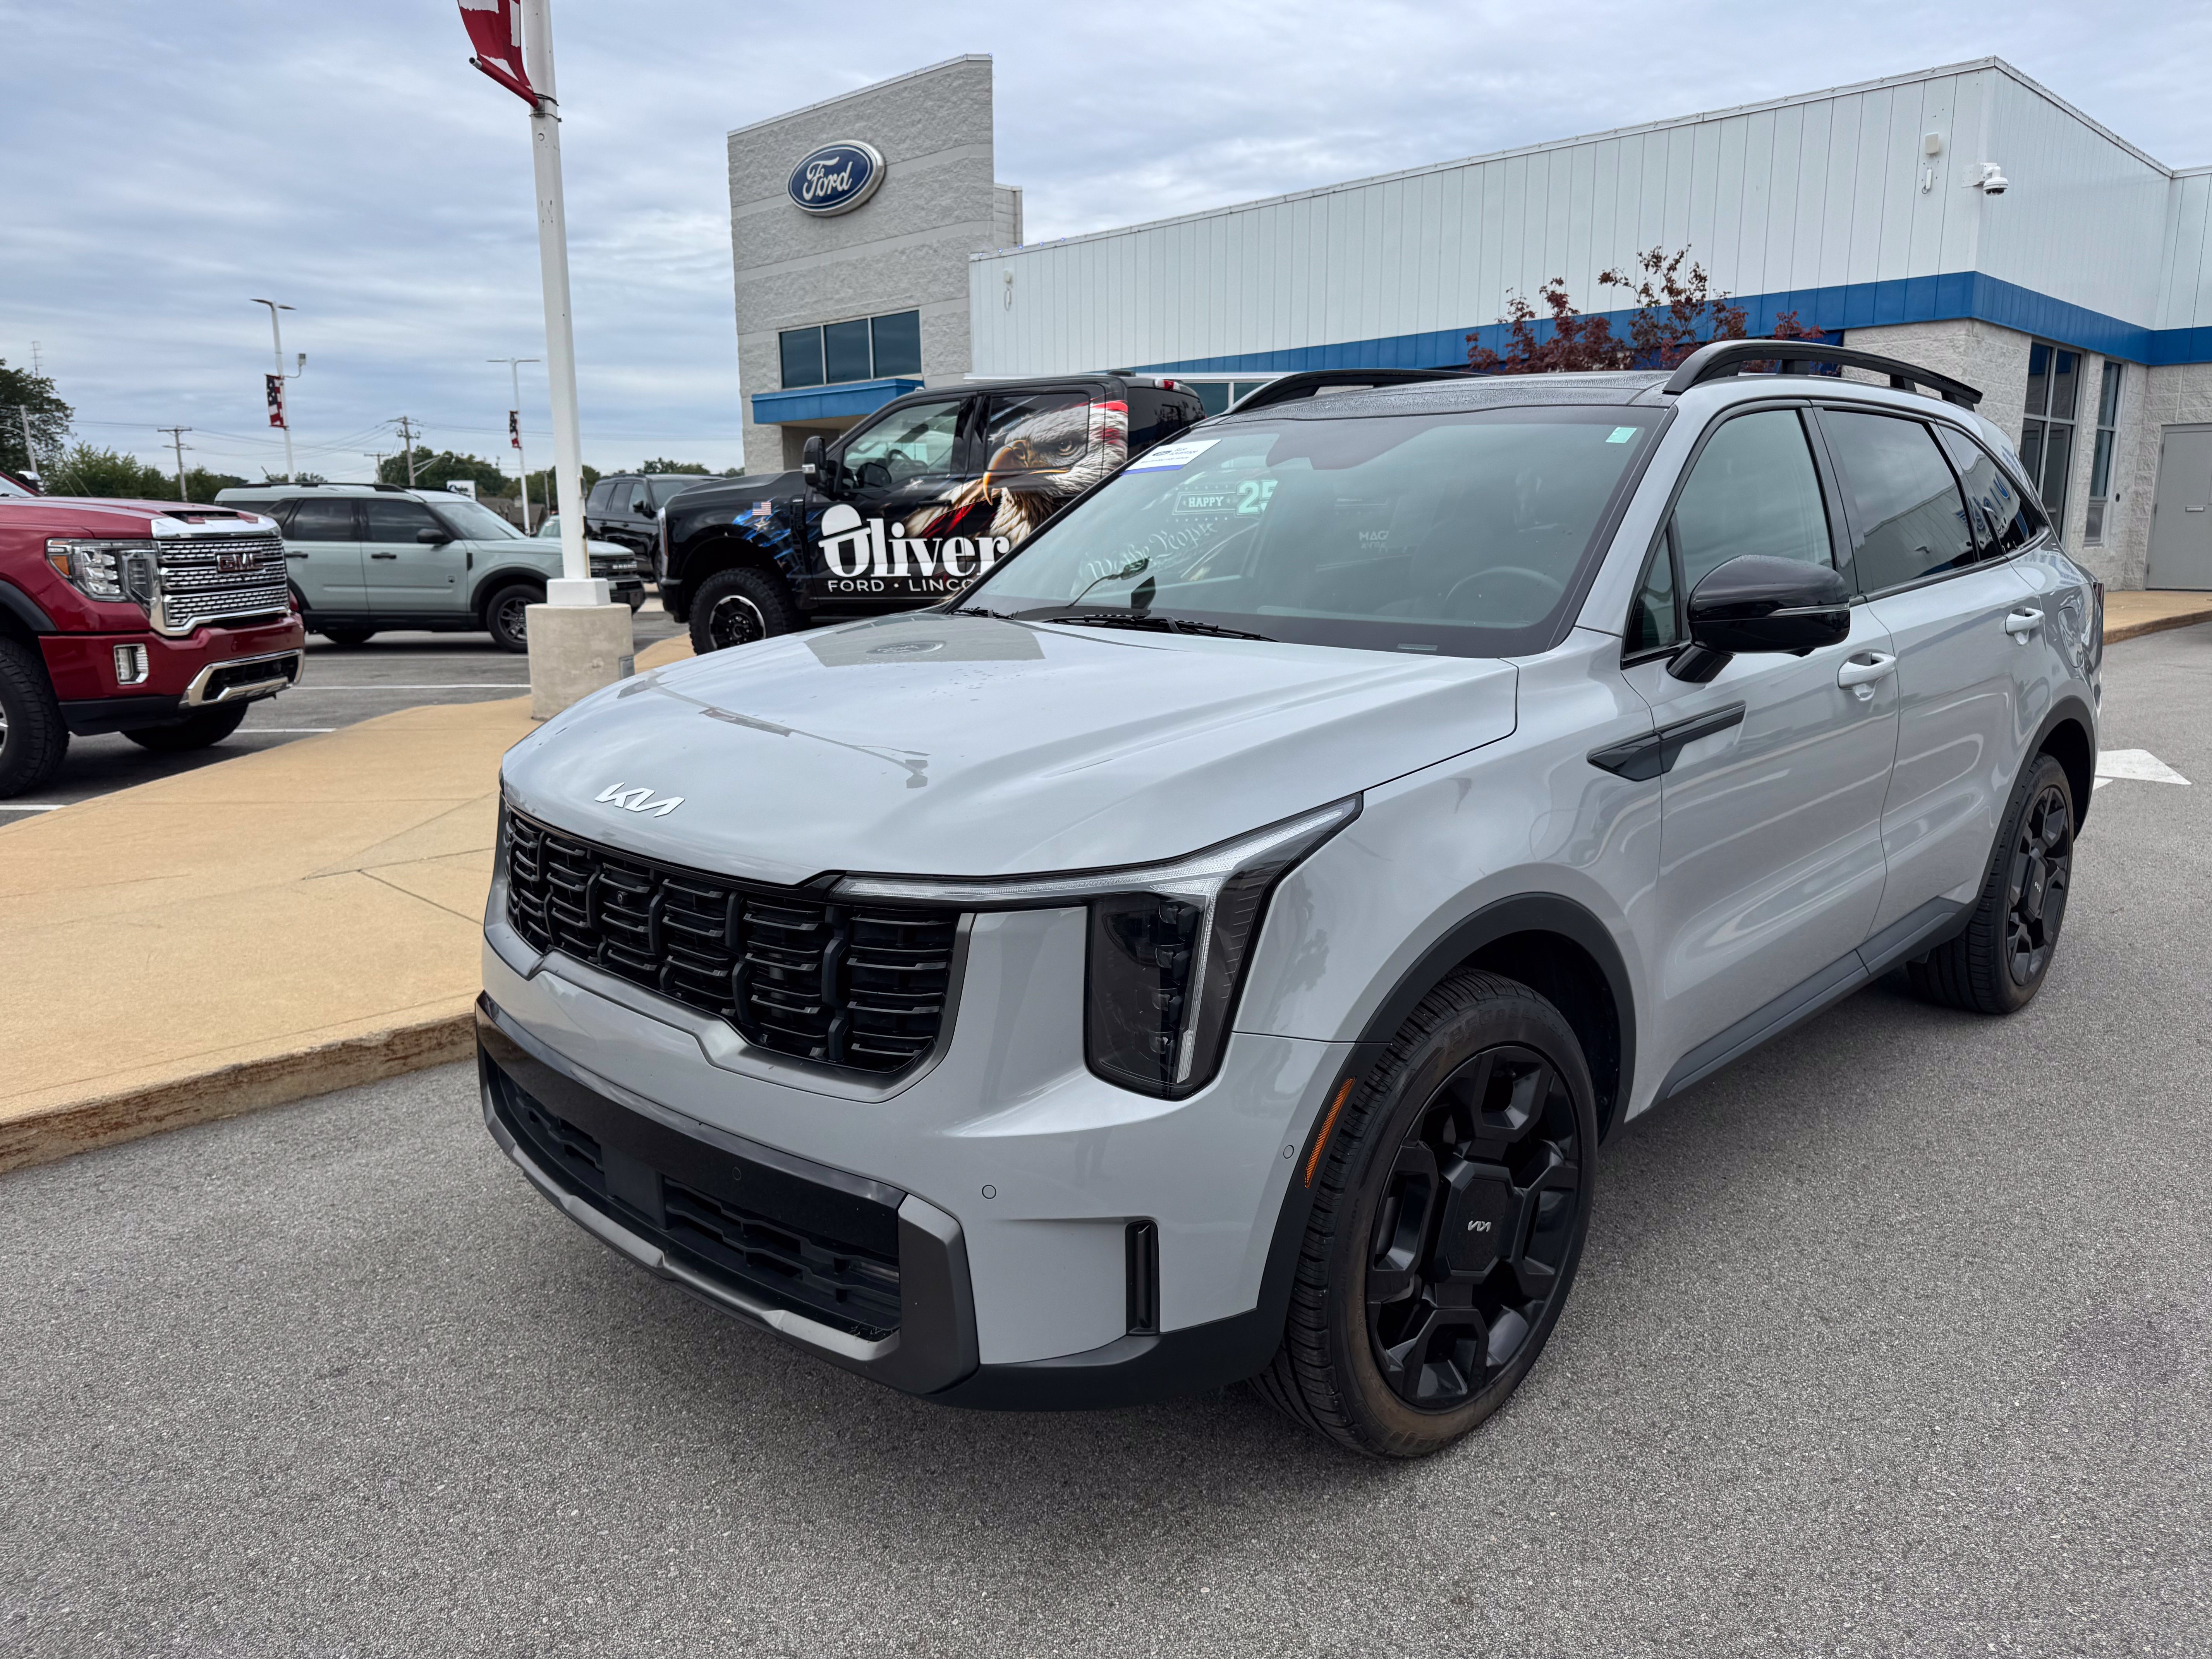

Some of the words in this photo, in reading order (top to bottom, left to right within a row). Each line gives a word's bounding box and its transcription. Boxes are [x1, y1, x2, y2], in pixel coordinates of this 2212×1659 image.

[802, 156, 853, 200] Ford
[1188, 496, 1224, 507] HAPPY
[818, 504, 1010, 577] Oliver
[216, 553, 264, 572] GMC
[828, 579, 884, 592] FORD
[594, 781, 685, 817] KIA
